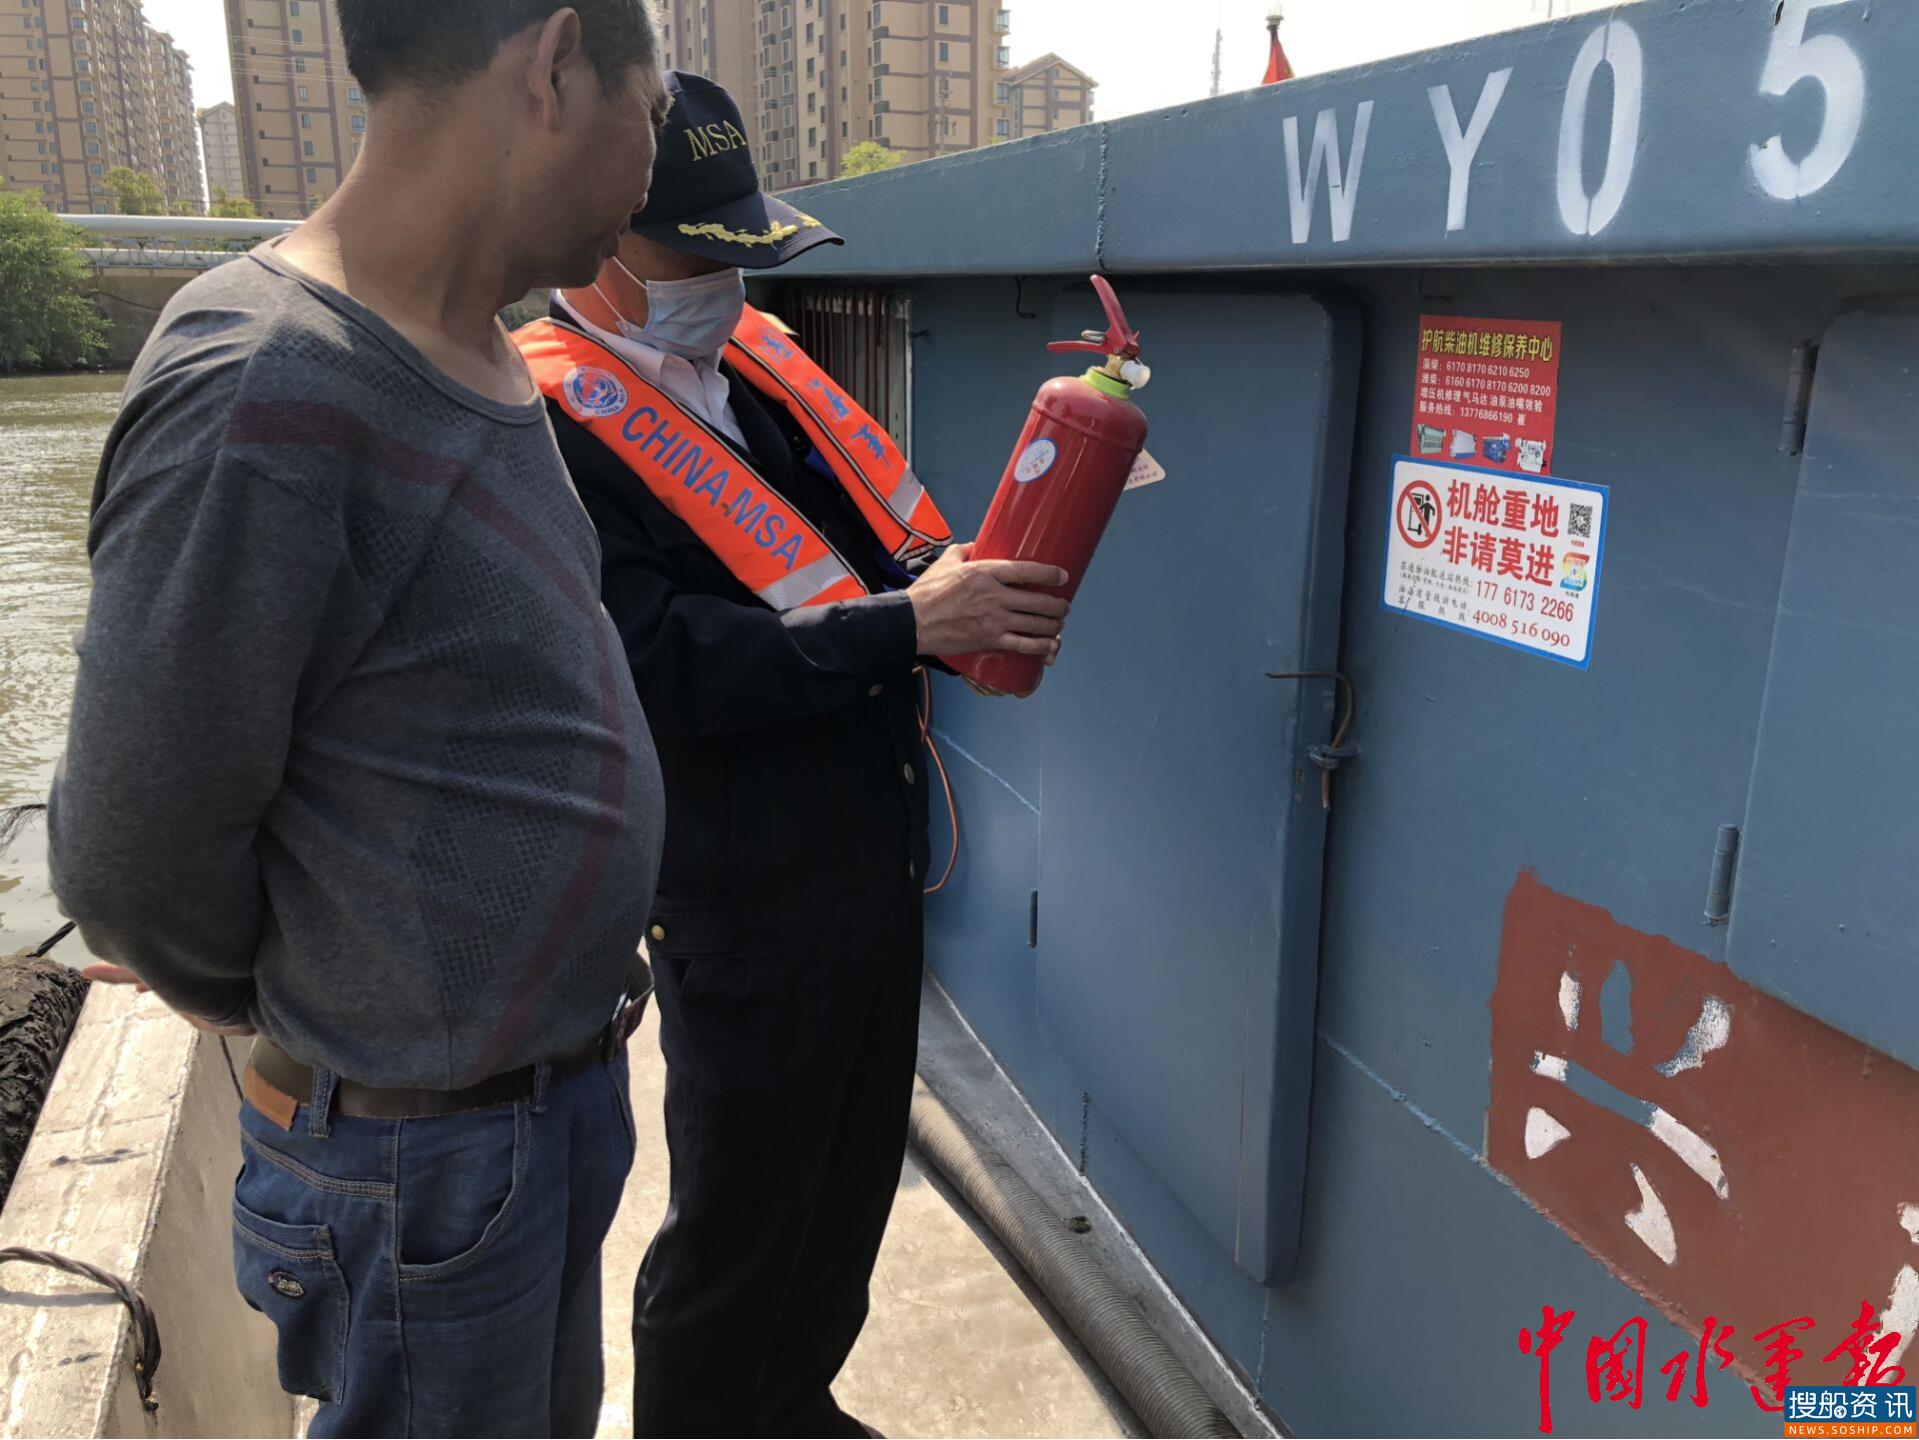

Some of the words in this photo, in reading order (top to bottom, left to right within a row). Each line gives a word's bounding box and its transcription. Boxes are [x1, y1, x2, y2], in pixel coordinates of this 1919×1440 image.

[684, 120, 746, 161] MSA
[1421, 329, 1552, 361] 护航柴油机维修保养中心
[1445, 376, 1464, 388] 6160
[1466, 378, 1485, 390] 6170
[1486, 379, 1506, 392] 8170
[1508, 382, 1528, 394] 6200
[1530, 384, 1551, 397] 8200
[1446, 361, 1465, 373] 6170
[1467, 363, 1487, 375] 8170
[1488, 365, 1508, 376] 6210
[1509, 367, 1530, 378] 6250
[621, 406, 731, 507] CHINA
[731, 487, 807, 570] MSA
[1447, 479, 1559, 538] 机舱重地
[1442, 526, 1555, 587] 非请莫进
[1476, 580, 1498, 601] 177
[1504, 587, 1534, 611] 6173
[1540, 596, 1574, 622] 2266
[1473, 609, 1507, 629] 4008
[1511, 620, 1538, 637] 516
[1541, 629, 1570, 647] 090
